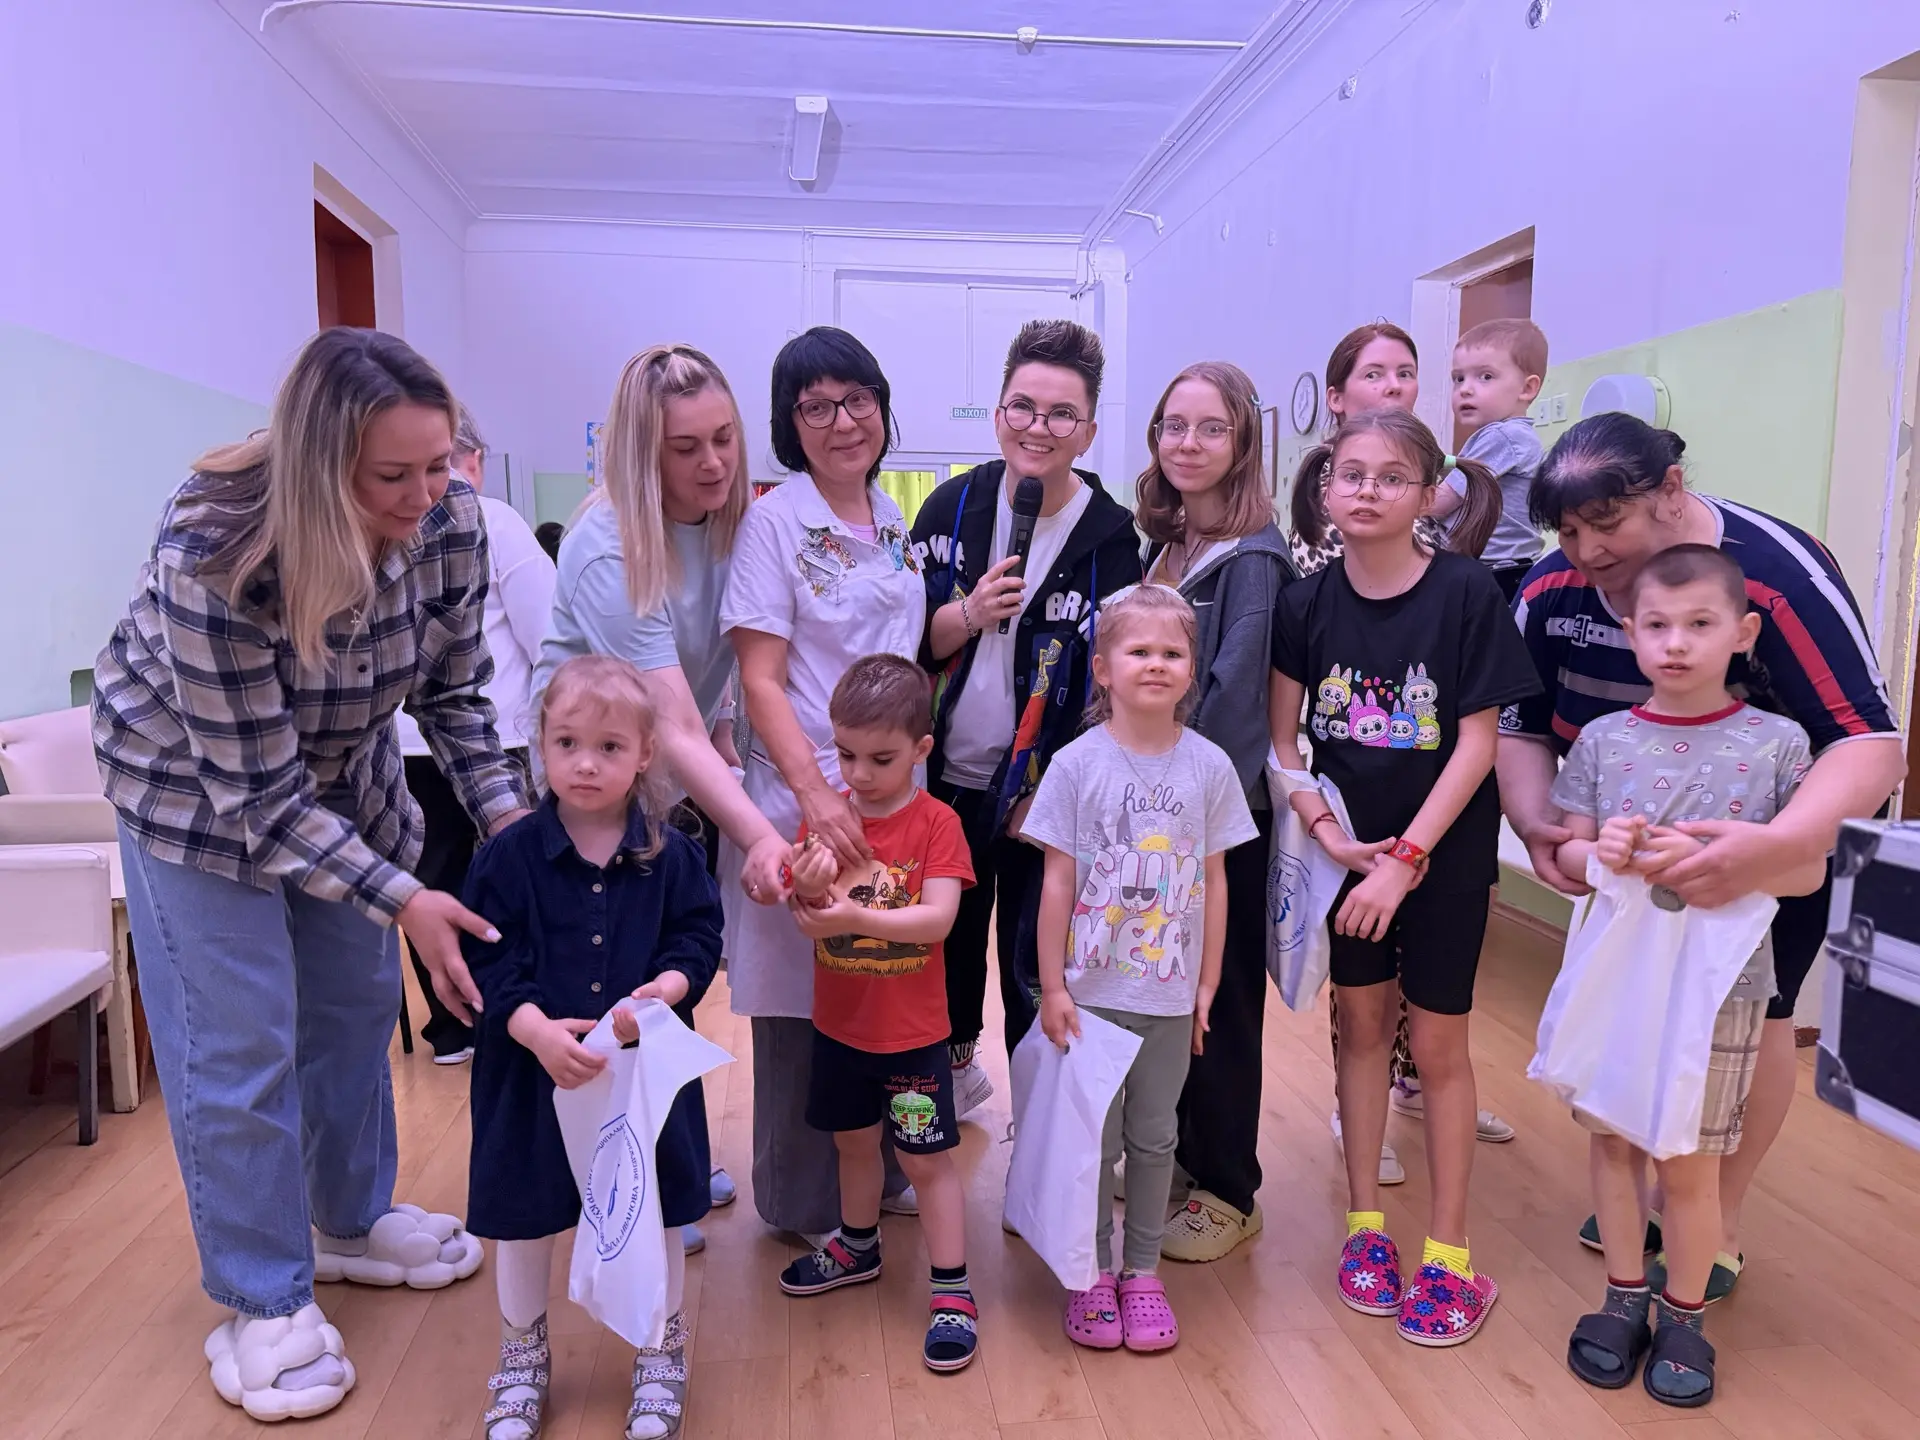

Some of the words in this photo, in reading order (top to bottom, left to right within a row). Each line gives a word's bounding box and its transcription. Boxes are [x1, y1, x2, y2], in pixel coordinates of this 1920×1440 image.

[954, 408, 986, 418] ВЫХОД
[1119, 782, 1185, 816] hello
[1079, 850, 1198, 916] SUM
[920, 1083, 940, 1093] SURF
[907, 1104, 933, 1114] SURFING
[925, 1126, 935, 1135] OF
[894, 1129, 909, 1143] REAL
[909, 1136, 924, 1144] INC.
[924, 1131, 944, 1144] WEAR
